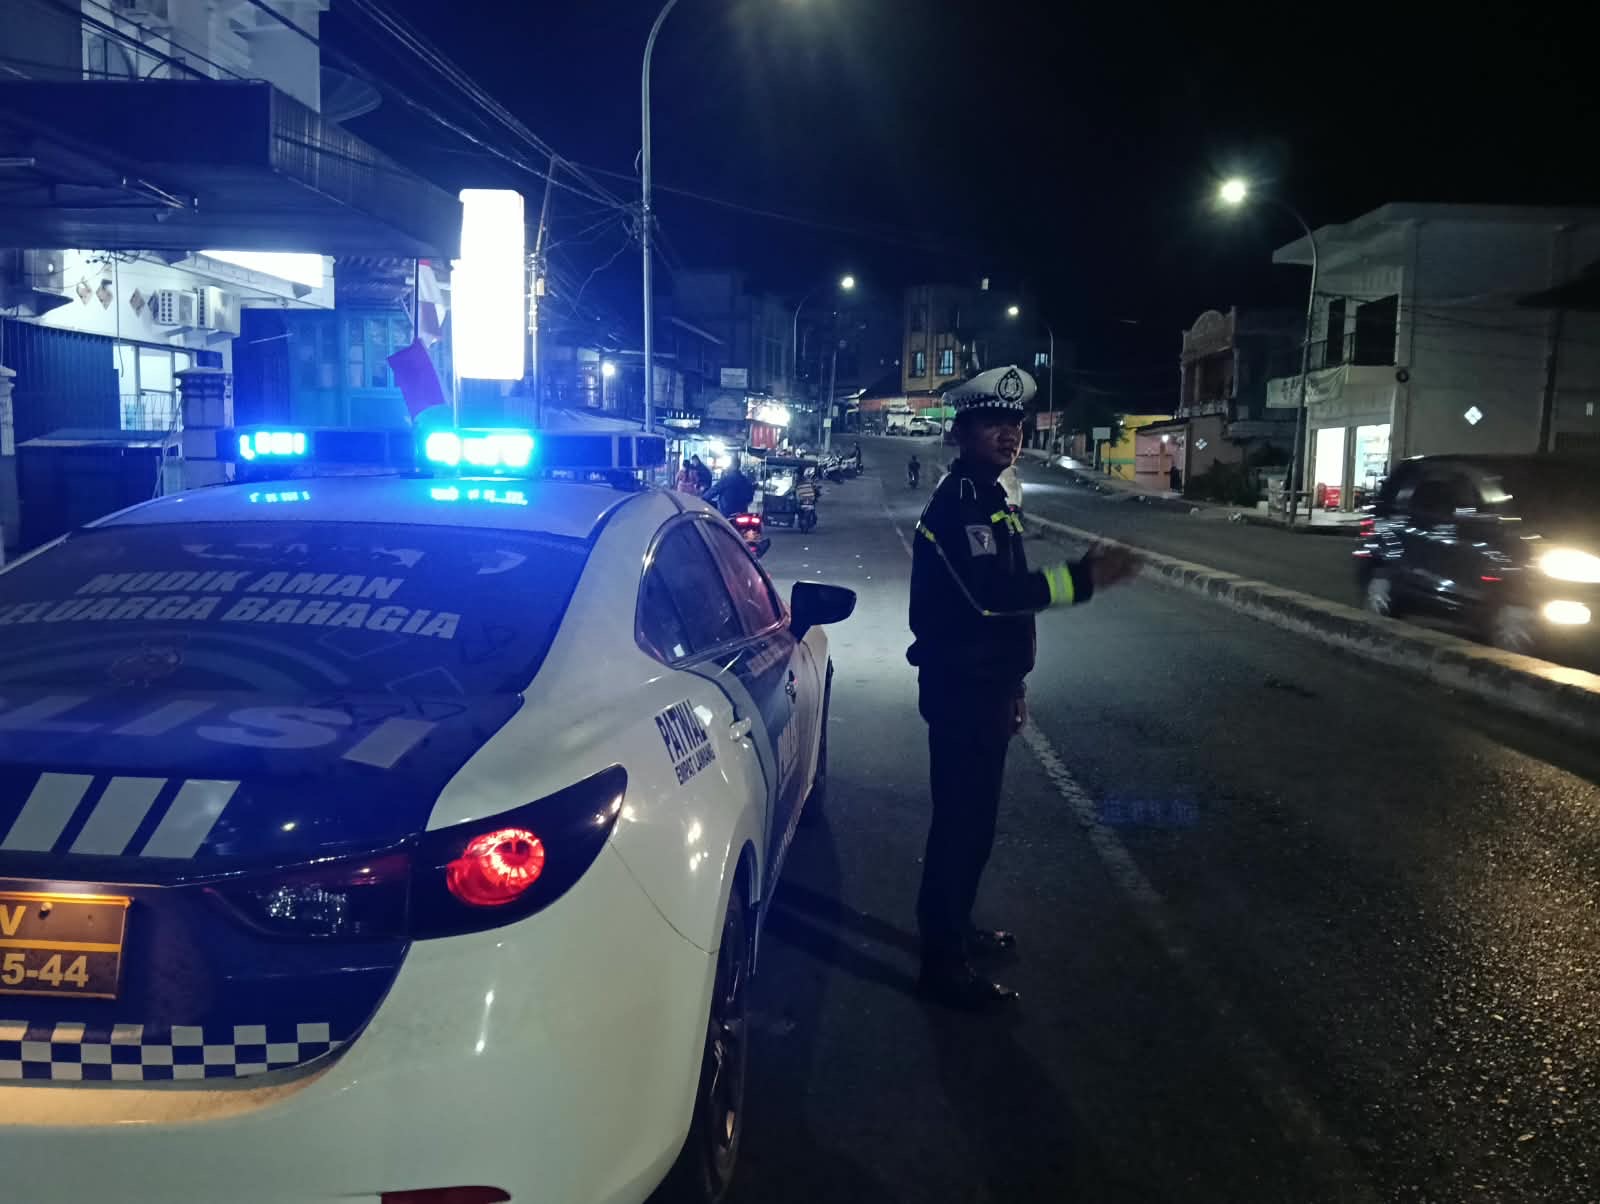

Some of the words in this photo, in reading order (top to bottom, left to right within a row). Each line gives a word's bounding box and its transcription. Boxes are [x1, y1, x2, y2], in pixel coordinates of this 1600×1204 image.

[75, 572, 250, 595] MUDIK
[247, 572, 404, 599] AMAN
[0, 597, 222, 625] ELUARGA
[221, 599, 461, 639] BAHAGIA
[655, 699, 708, 763] PATWAL
